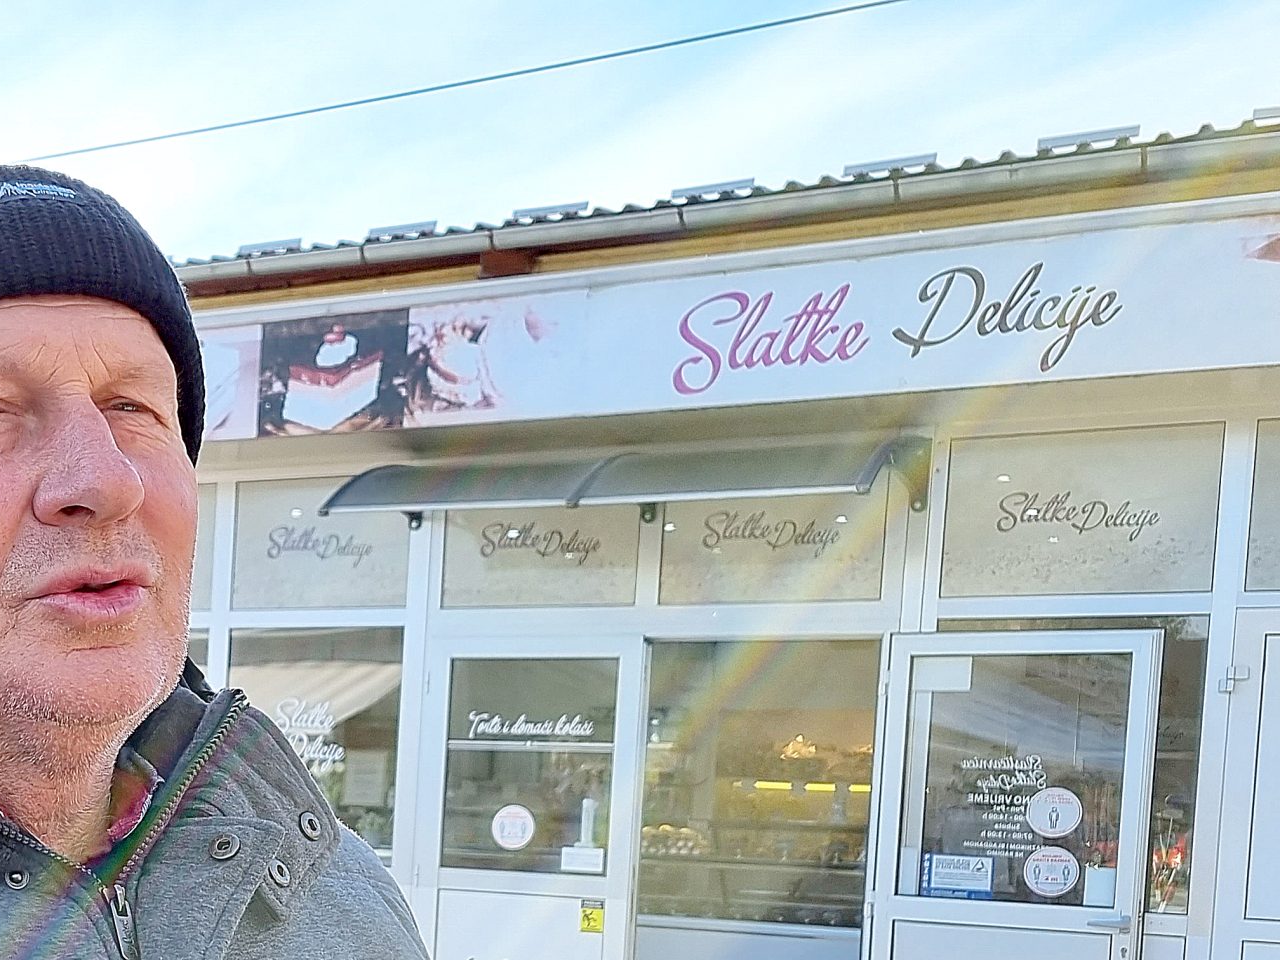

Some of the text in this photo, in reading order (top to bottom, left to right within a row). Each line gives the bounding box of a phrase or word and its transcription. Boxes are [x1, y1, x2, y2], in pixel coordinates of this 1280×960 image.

[671, 261, 1122, 396] Slatke Delicije
[702, 510, 840, 558] Slatke Delicije
[997, 491, 1160, 541] Slatke Delicije
[275, 697, 337, 734] Slatke
[287, 732, 346, 774] Delicije
